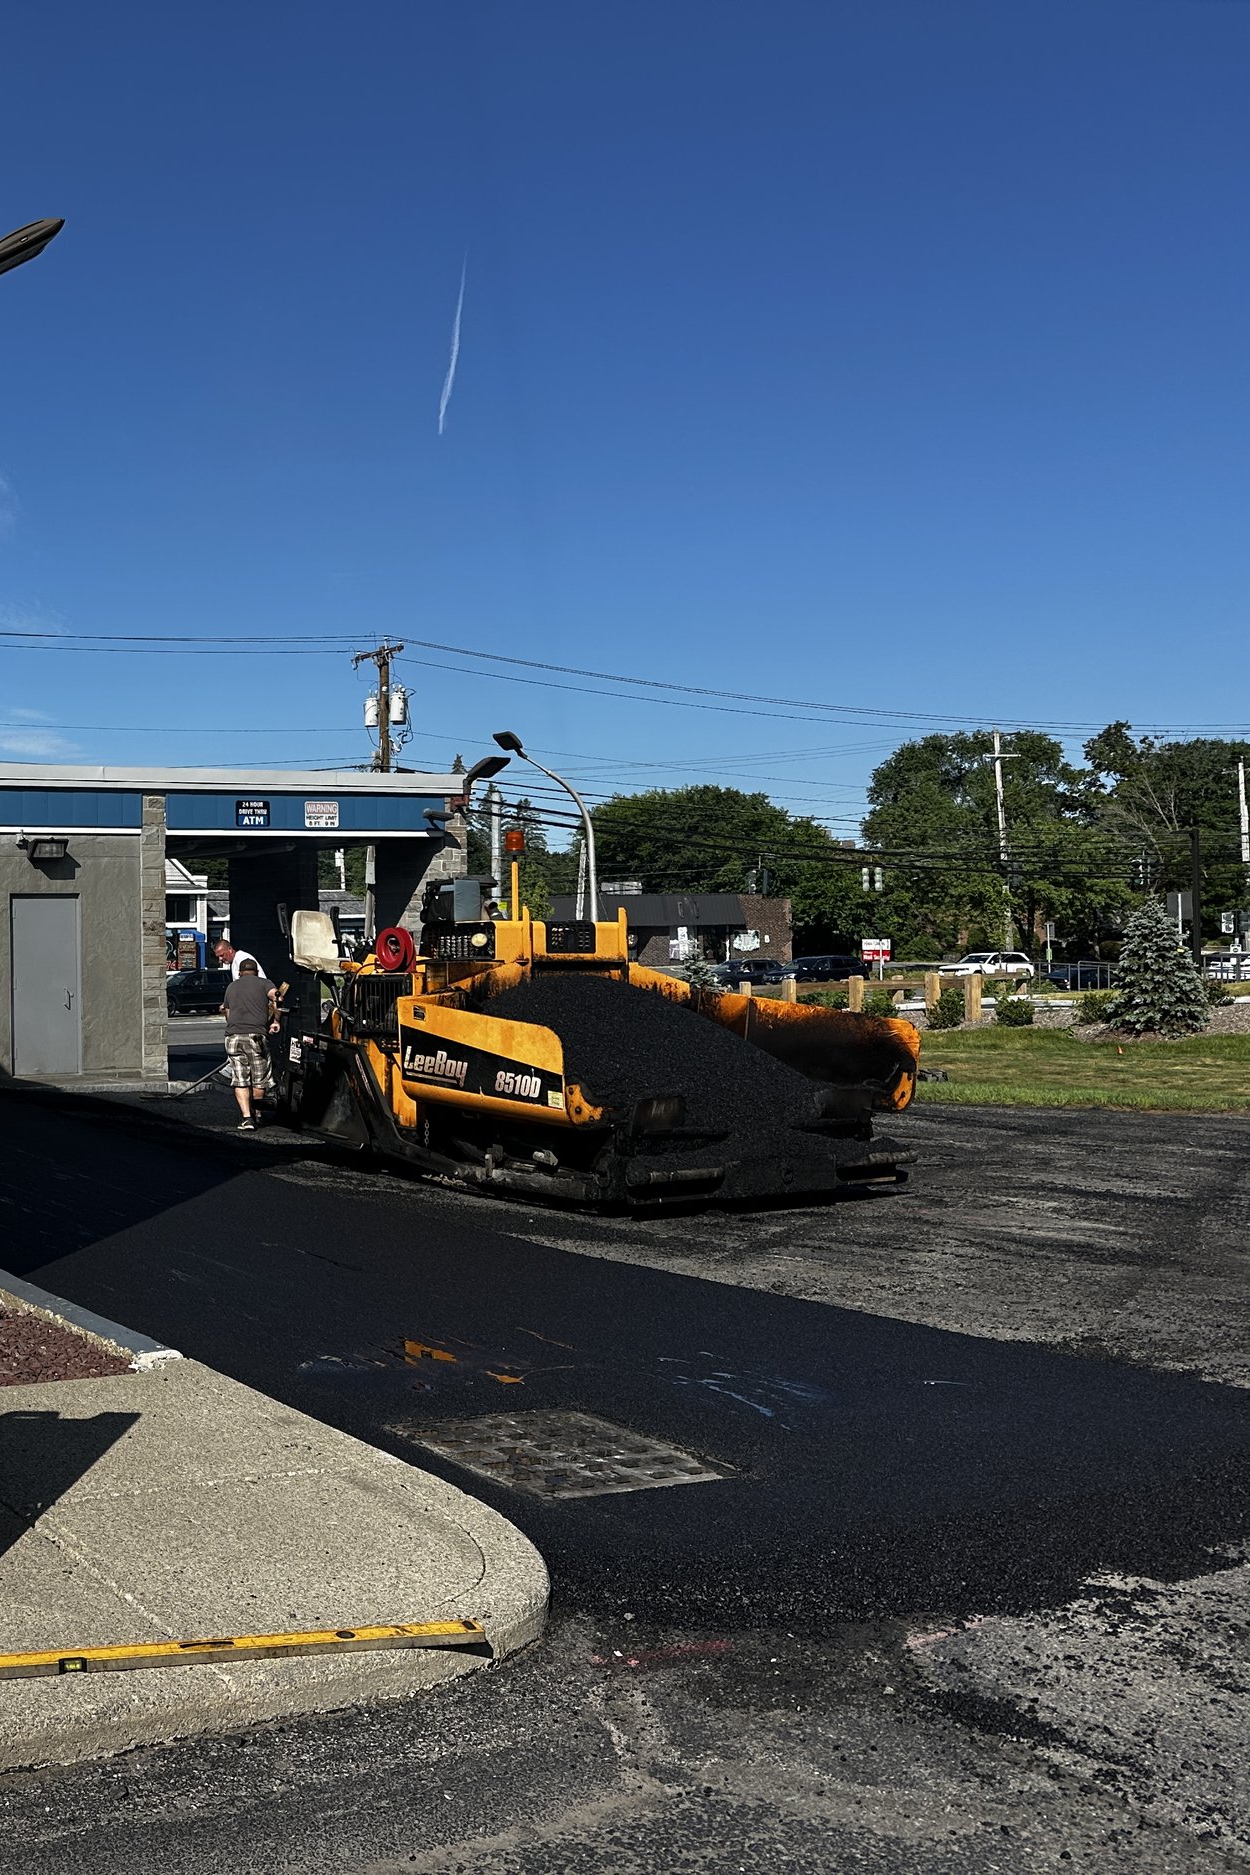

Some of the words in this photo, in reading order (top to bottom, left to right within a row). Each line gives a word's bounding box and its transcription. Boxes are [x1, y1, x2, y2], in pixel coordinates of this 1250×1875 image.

[306, 804, 337, 813] WARNING
[243, 816, 264, 825] ATM
[403, 1045, 468, 1087] LeeBoy
[494, 1070, 541, 1098] 8510D
